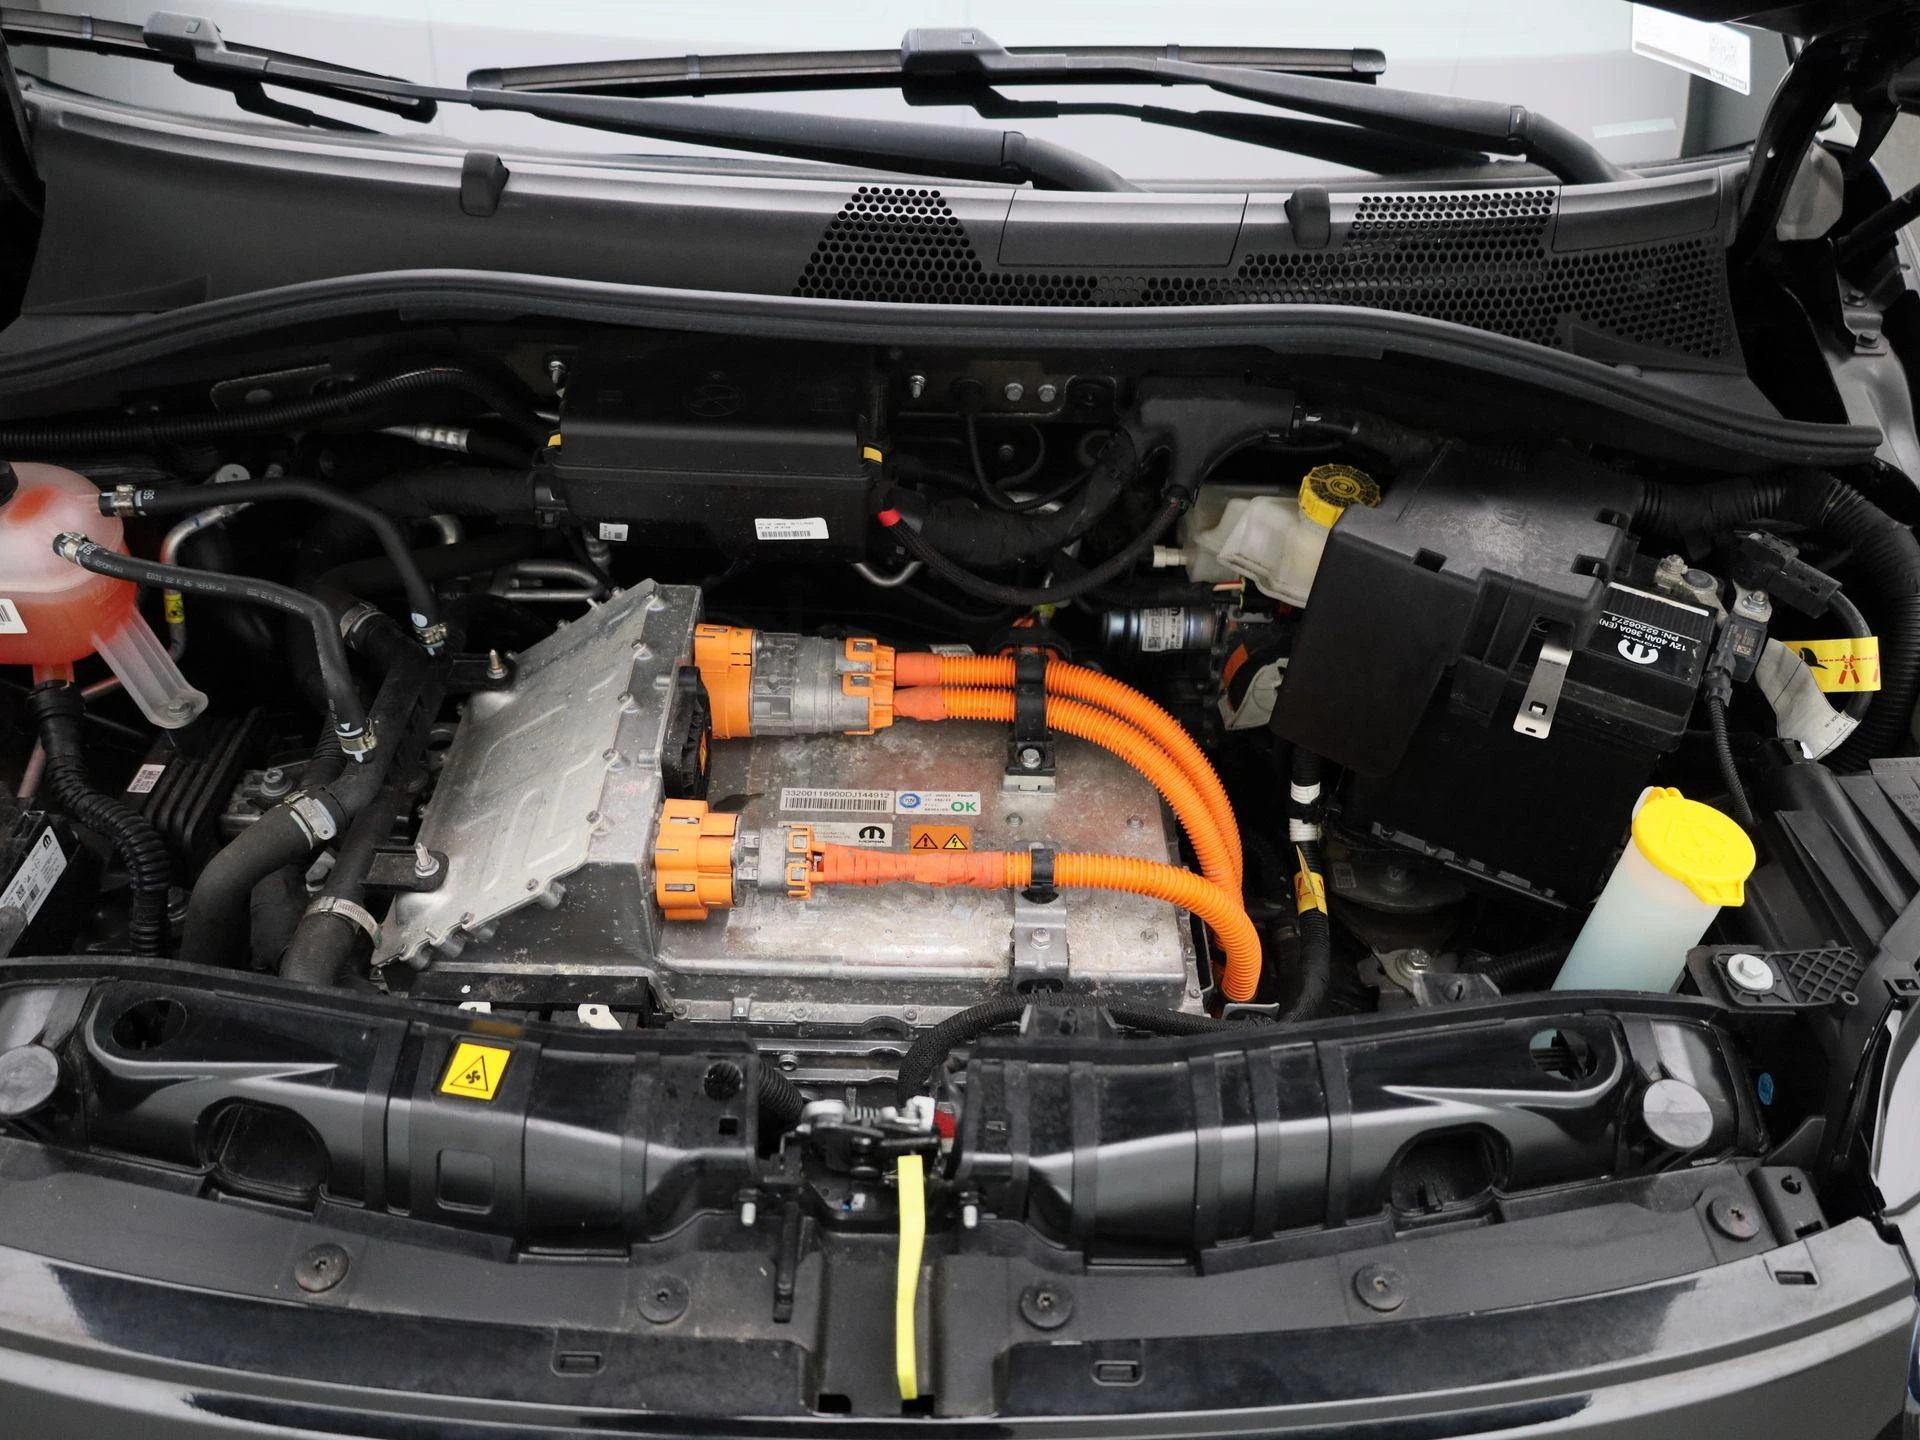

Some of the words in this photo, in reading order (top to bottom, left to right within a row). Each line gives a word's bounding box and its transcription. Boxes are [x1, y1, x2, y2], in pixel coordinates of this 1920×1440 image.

[1599, 618, 1618, 629] (EN)
[1611, 616, 1659, 635] 52206274
[1620, 625, 1643, 637] 360A
[1661, 631, 1679, 642] PN:
[1644, 633, 1668, 645] 40Ah
[1669, 642, 1687, 652] 12V
[951, 801, 977, 812] OK
